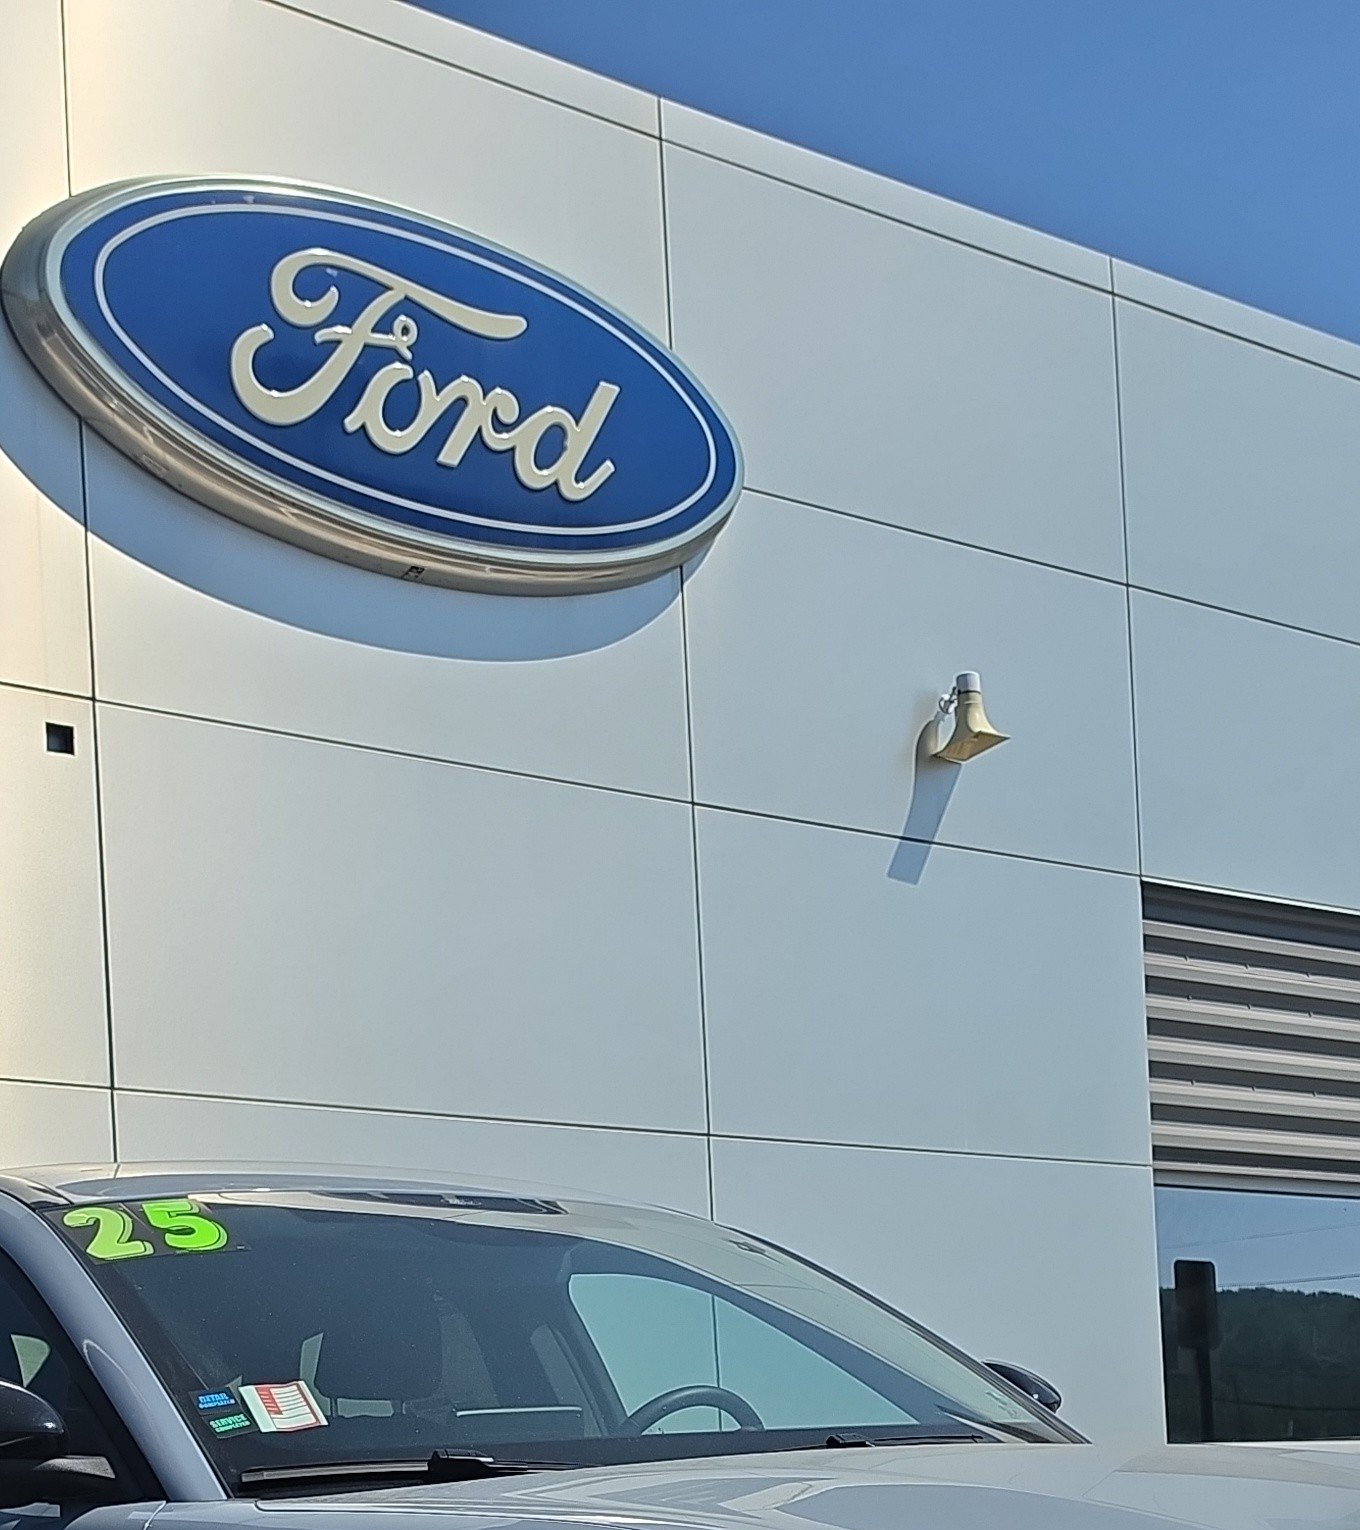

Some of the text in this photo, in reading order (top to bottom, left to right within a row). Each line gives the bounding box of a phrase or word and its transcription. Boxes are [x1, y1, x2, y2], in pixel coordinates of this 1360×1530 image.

[229, 246, 622, 504] Ford
[61, 1197, 228, 1261] 25
[198, 1392, 230, 1405] DETAIL
[209, 1413, 248, 1428] SERVICE
